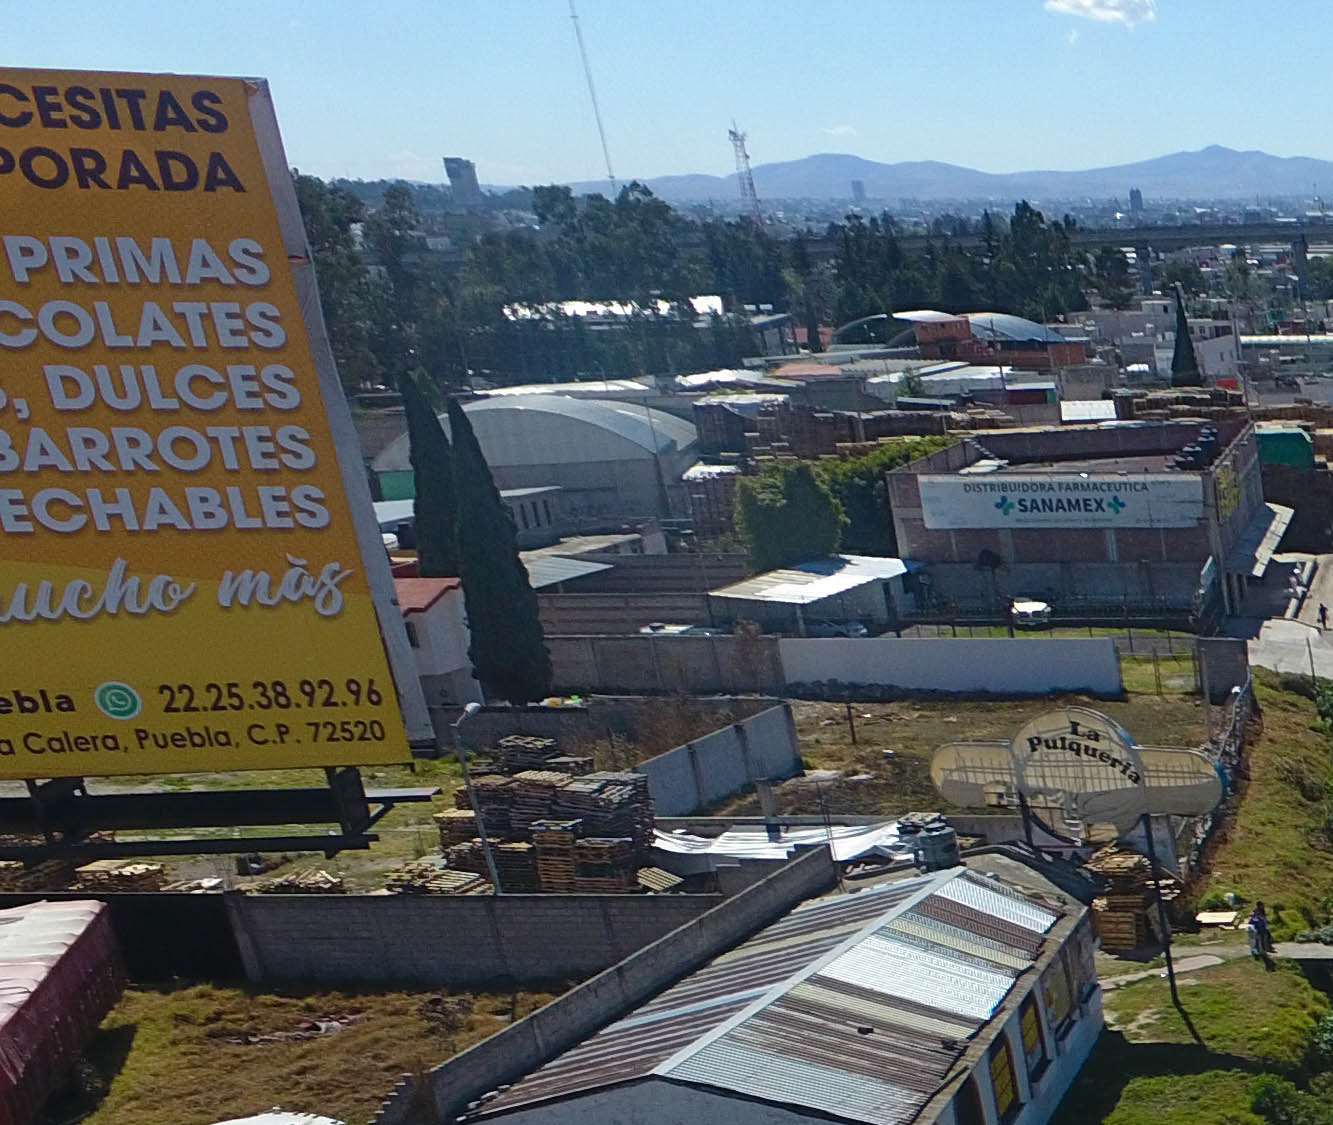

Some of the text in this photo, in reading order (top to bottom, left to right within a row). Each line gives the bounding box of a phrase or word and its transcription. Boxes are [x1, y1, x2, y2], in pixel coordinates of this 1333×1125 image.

[0, 83, 228, 133] CESITAS
[3, 235, 271, 286] PRIMAS
[0, 300, 286, 348] COLATES
[43, 364, 301, 411] DULCES
[0, 485, 330, 532] ECHABLES
[963, 482, 1055, 494] DISTRIBUIDORA
[1018, 498, 1107, 514] SANAMEX
[159, 678, 383, 713] 22.25.38.92.96
[23, 731, 129, 754] Calera,
[135, 727, 240, 750] Puebla,
[247, 722, 301, 745] C.P.
[307, 720, 385, 742] 72520
[1069, 720, 1100, 742] La
